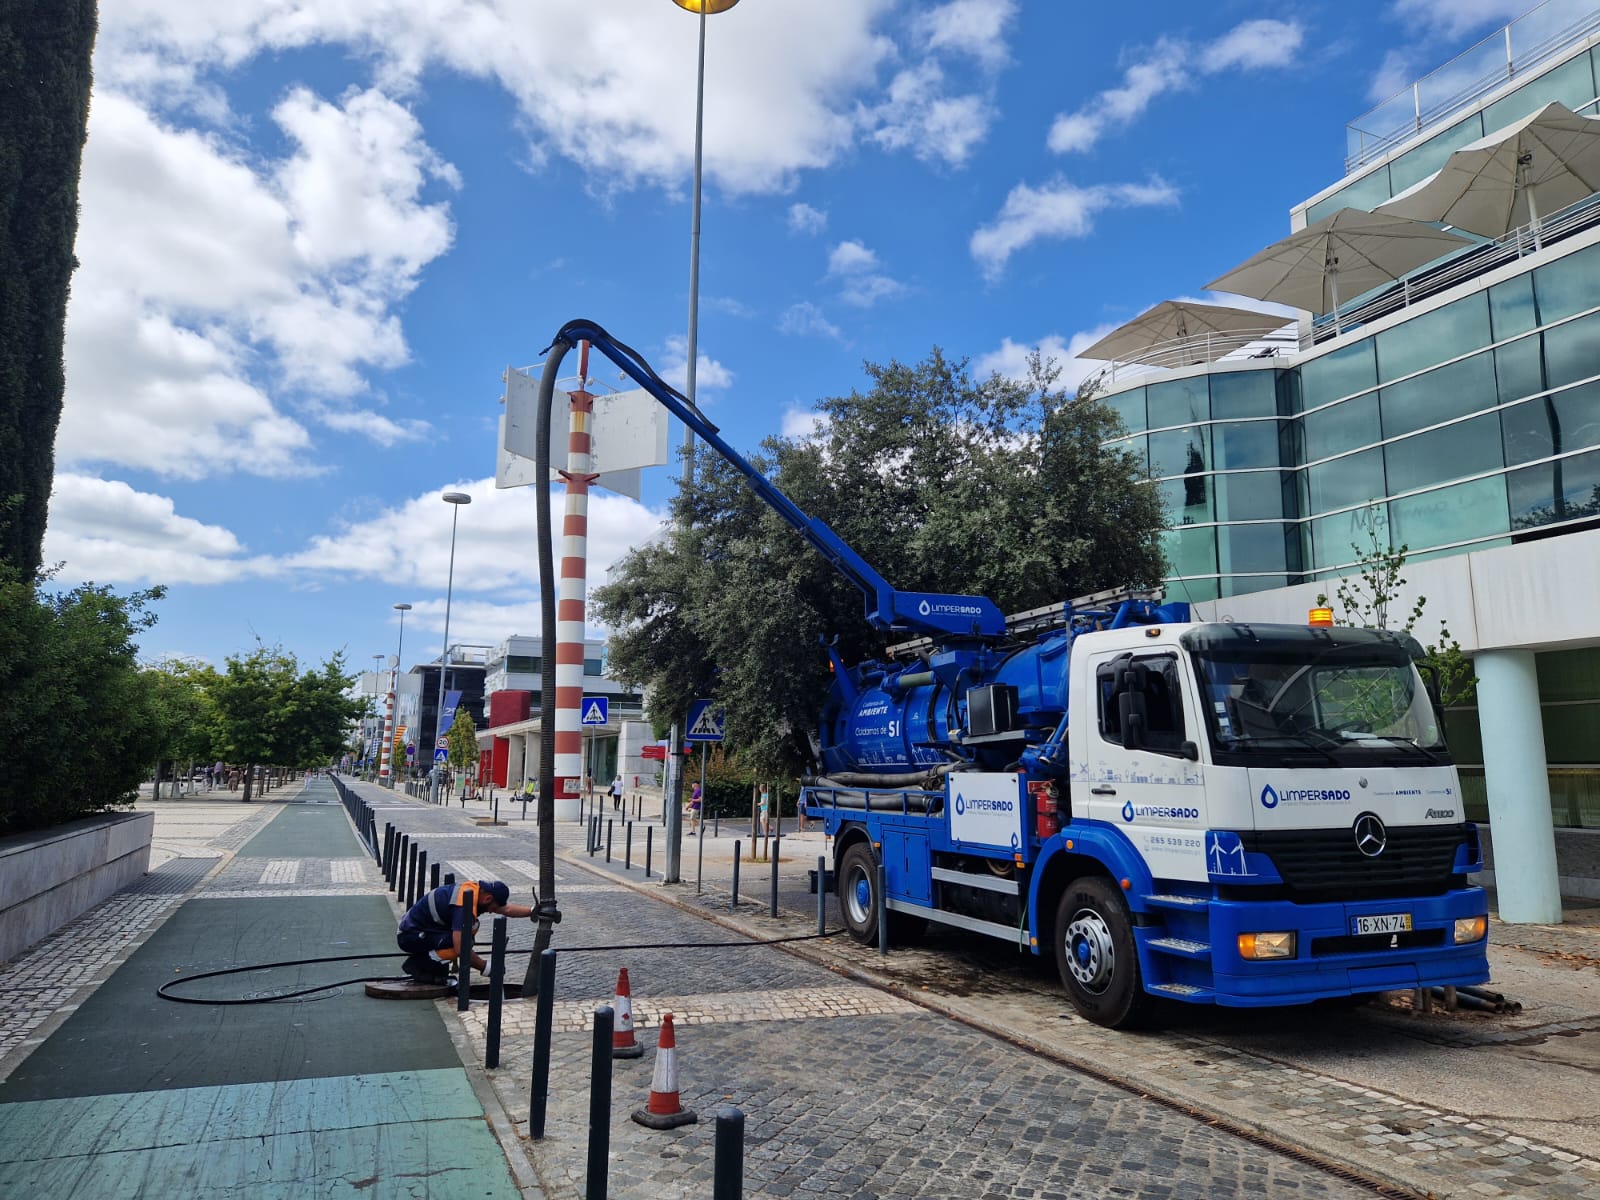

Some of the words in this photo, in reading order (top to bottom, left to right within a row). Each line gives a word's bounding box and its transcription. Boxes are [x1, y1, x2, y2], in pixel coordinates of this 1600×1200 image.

[931, 604, 982, 614] LIMPERSADO
[857, 705, 888, 717] AMBIENTE
[1279, 790, 1350, 801] LIMPERSADO
[965, 799, 1013, 812] LIMPERSADO
[1135, 806, 1199, 818] LIMPERSADO
[1184, 839, 1201, 848] 220
